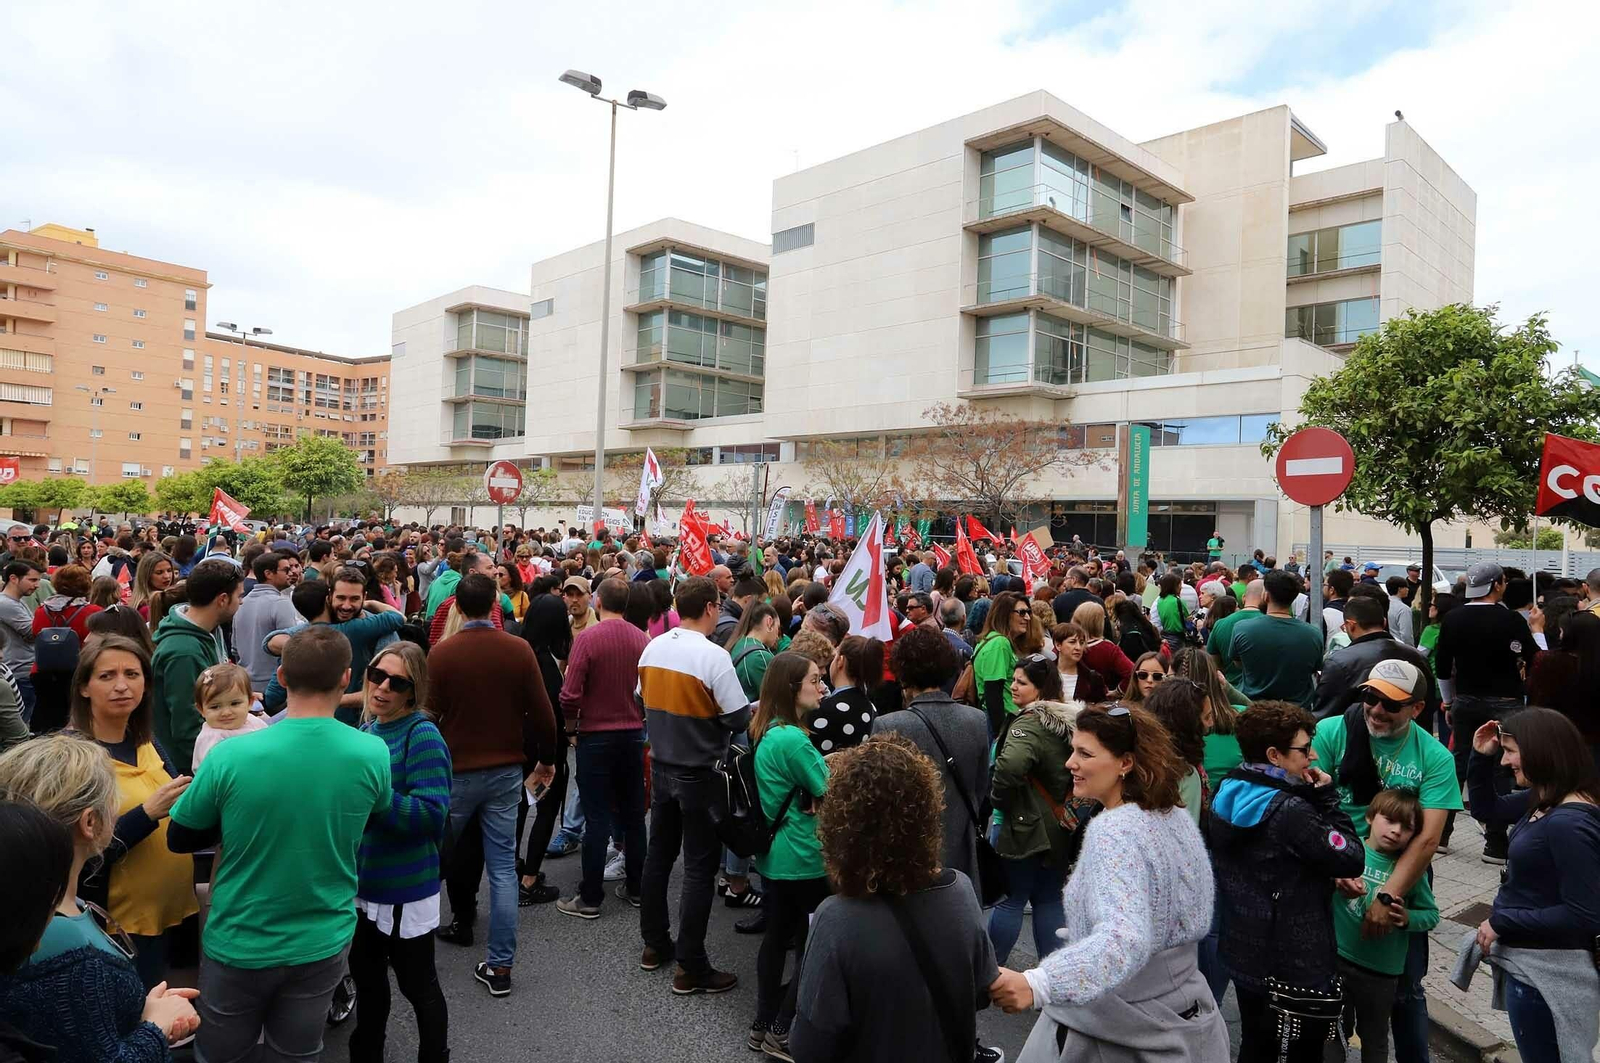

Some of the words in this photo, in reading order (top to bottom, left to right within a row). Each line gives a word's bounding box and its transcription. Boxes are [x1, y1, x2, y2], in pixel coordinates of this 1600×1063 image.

[1133, 477, 1141, 488] DE
[1132, 490, 1140, 515] JUNTA
[1281, 1037, 1289, 1054] YOUR
